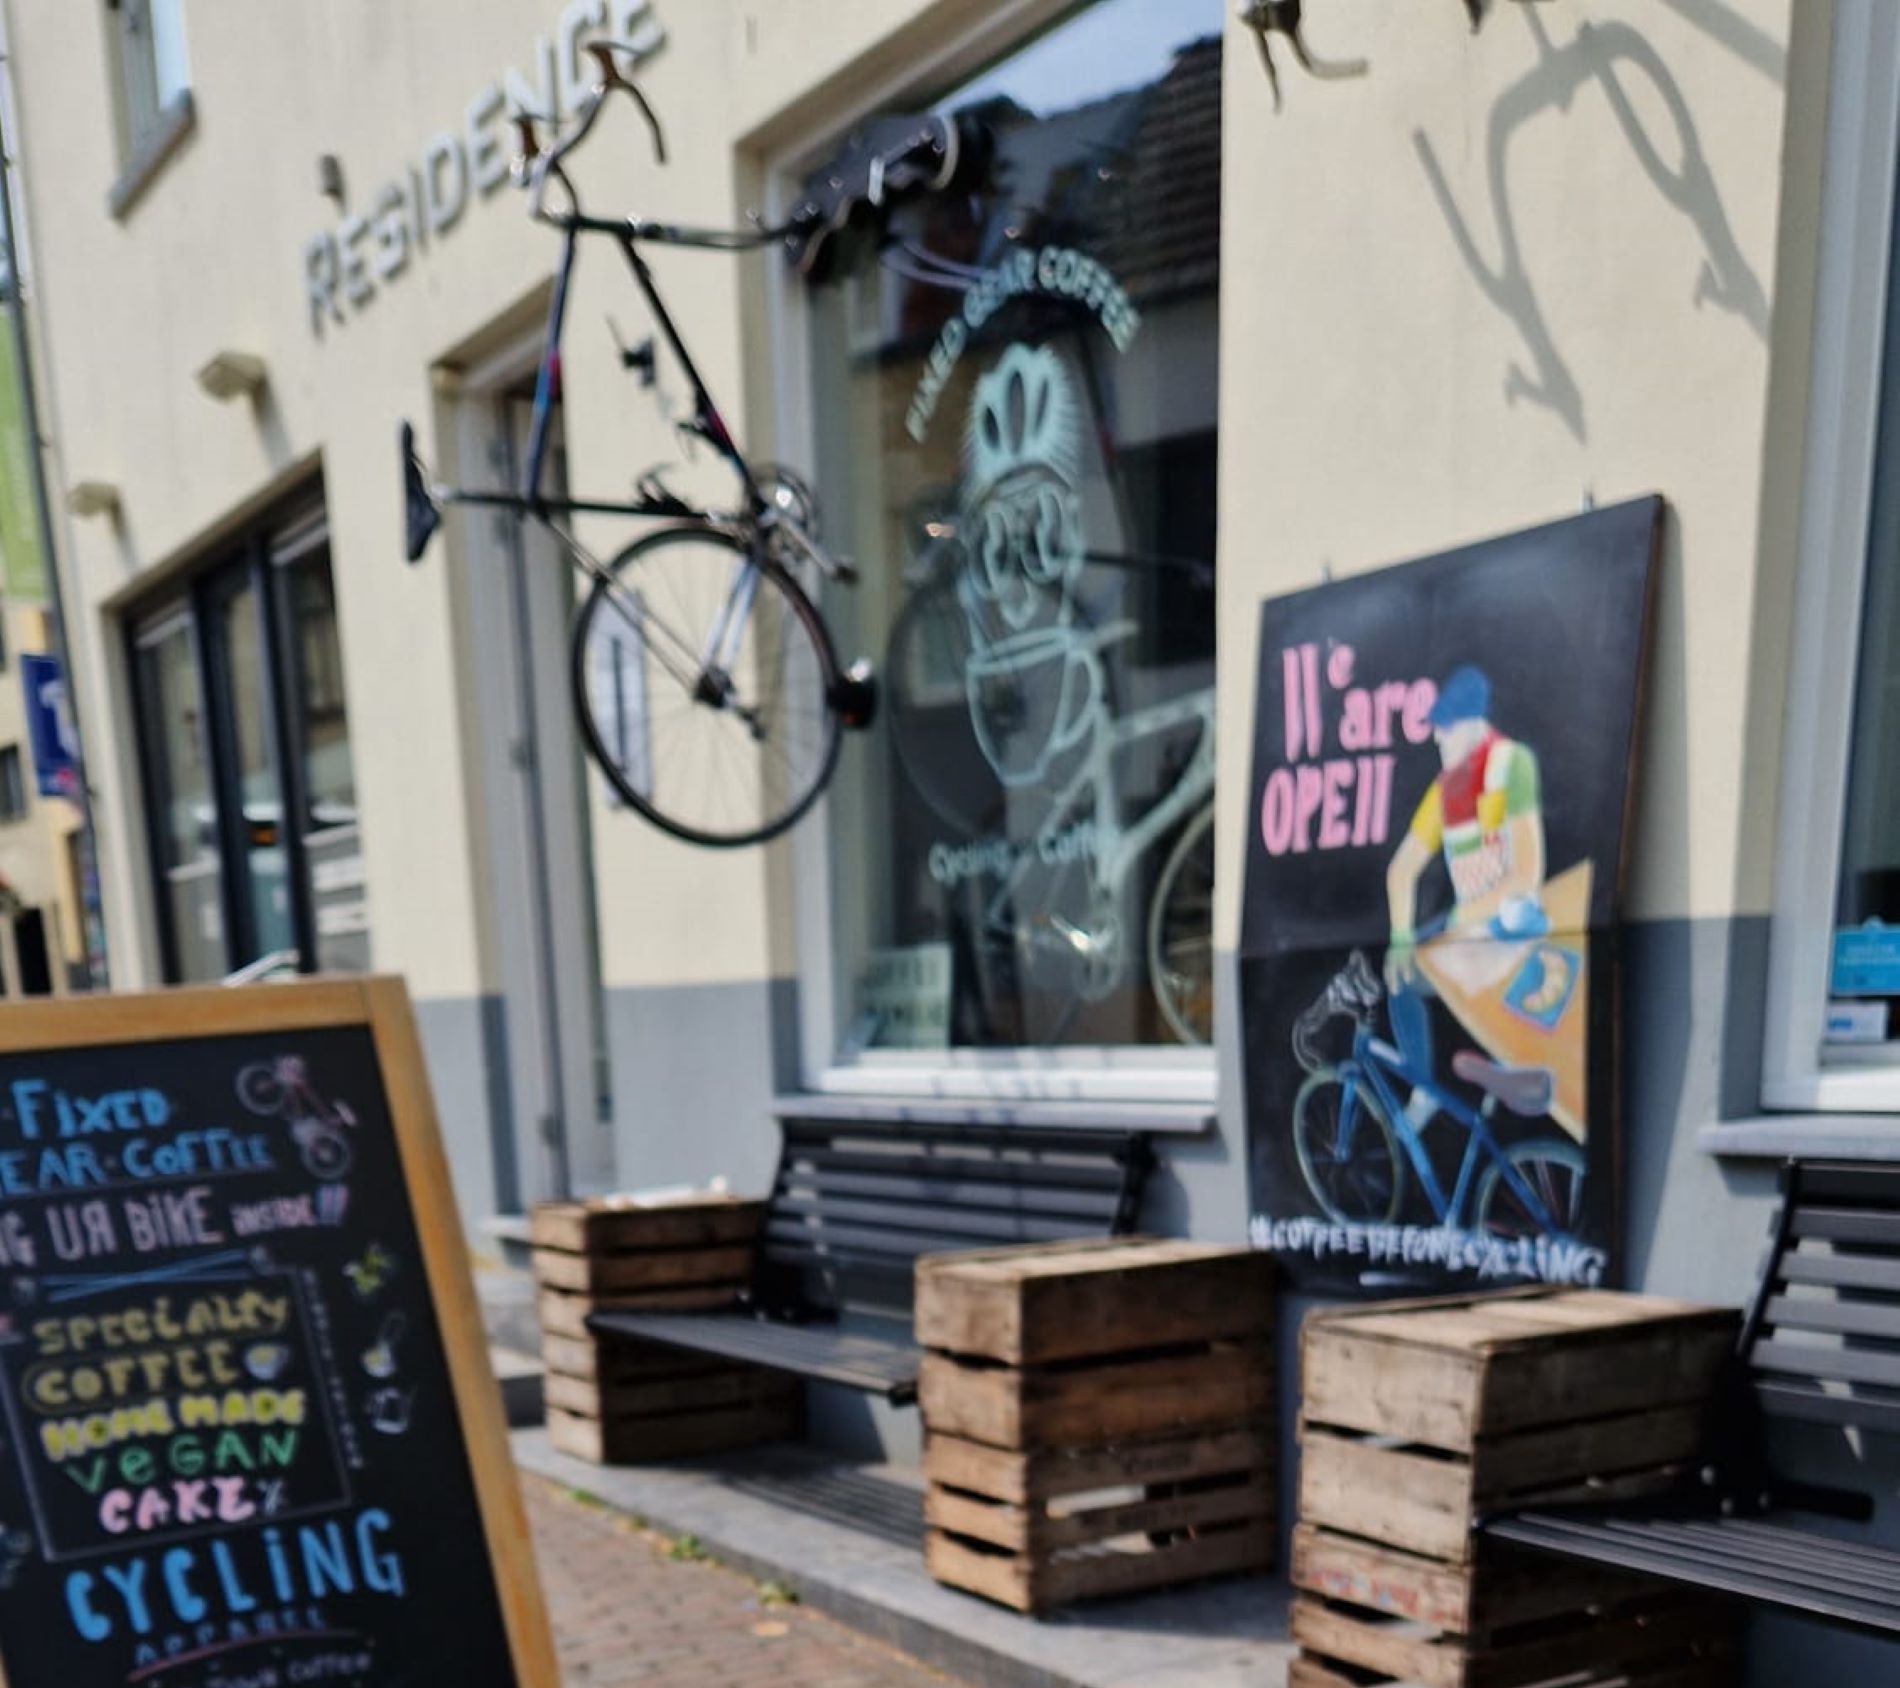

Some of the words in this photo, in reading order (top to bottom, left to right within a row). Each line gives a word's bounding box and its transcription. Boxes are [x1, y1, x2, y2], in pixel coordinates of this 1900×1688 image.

[303, 0, 666, 342] RESIDENCE
[905, 317, 966, 443] FIXED
[963, 250, 1037, 328] GEAR
[1038, 245, 1141, 354] COFFEE
[1338, 677, 1437, 752] are
[1261, 753, 1396, 857] OPEN
[0, 1140, 108, 1195] EAR
[34, 1339, 240, 1404] COFFEE
